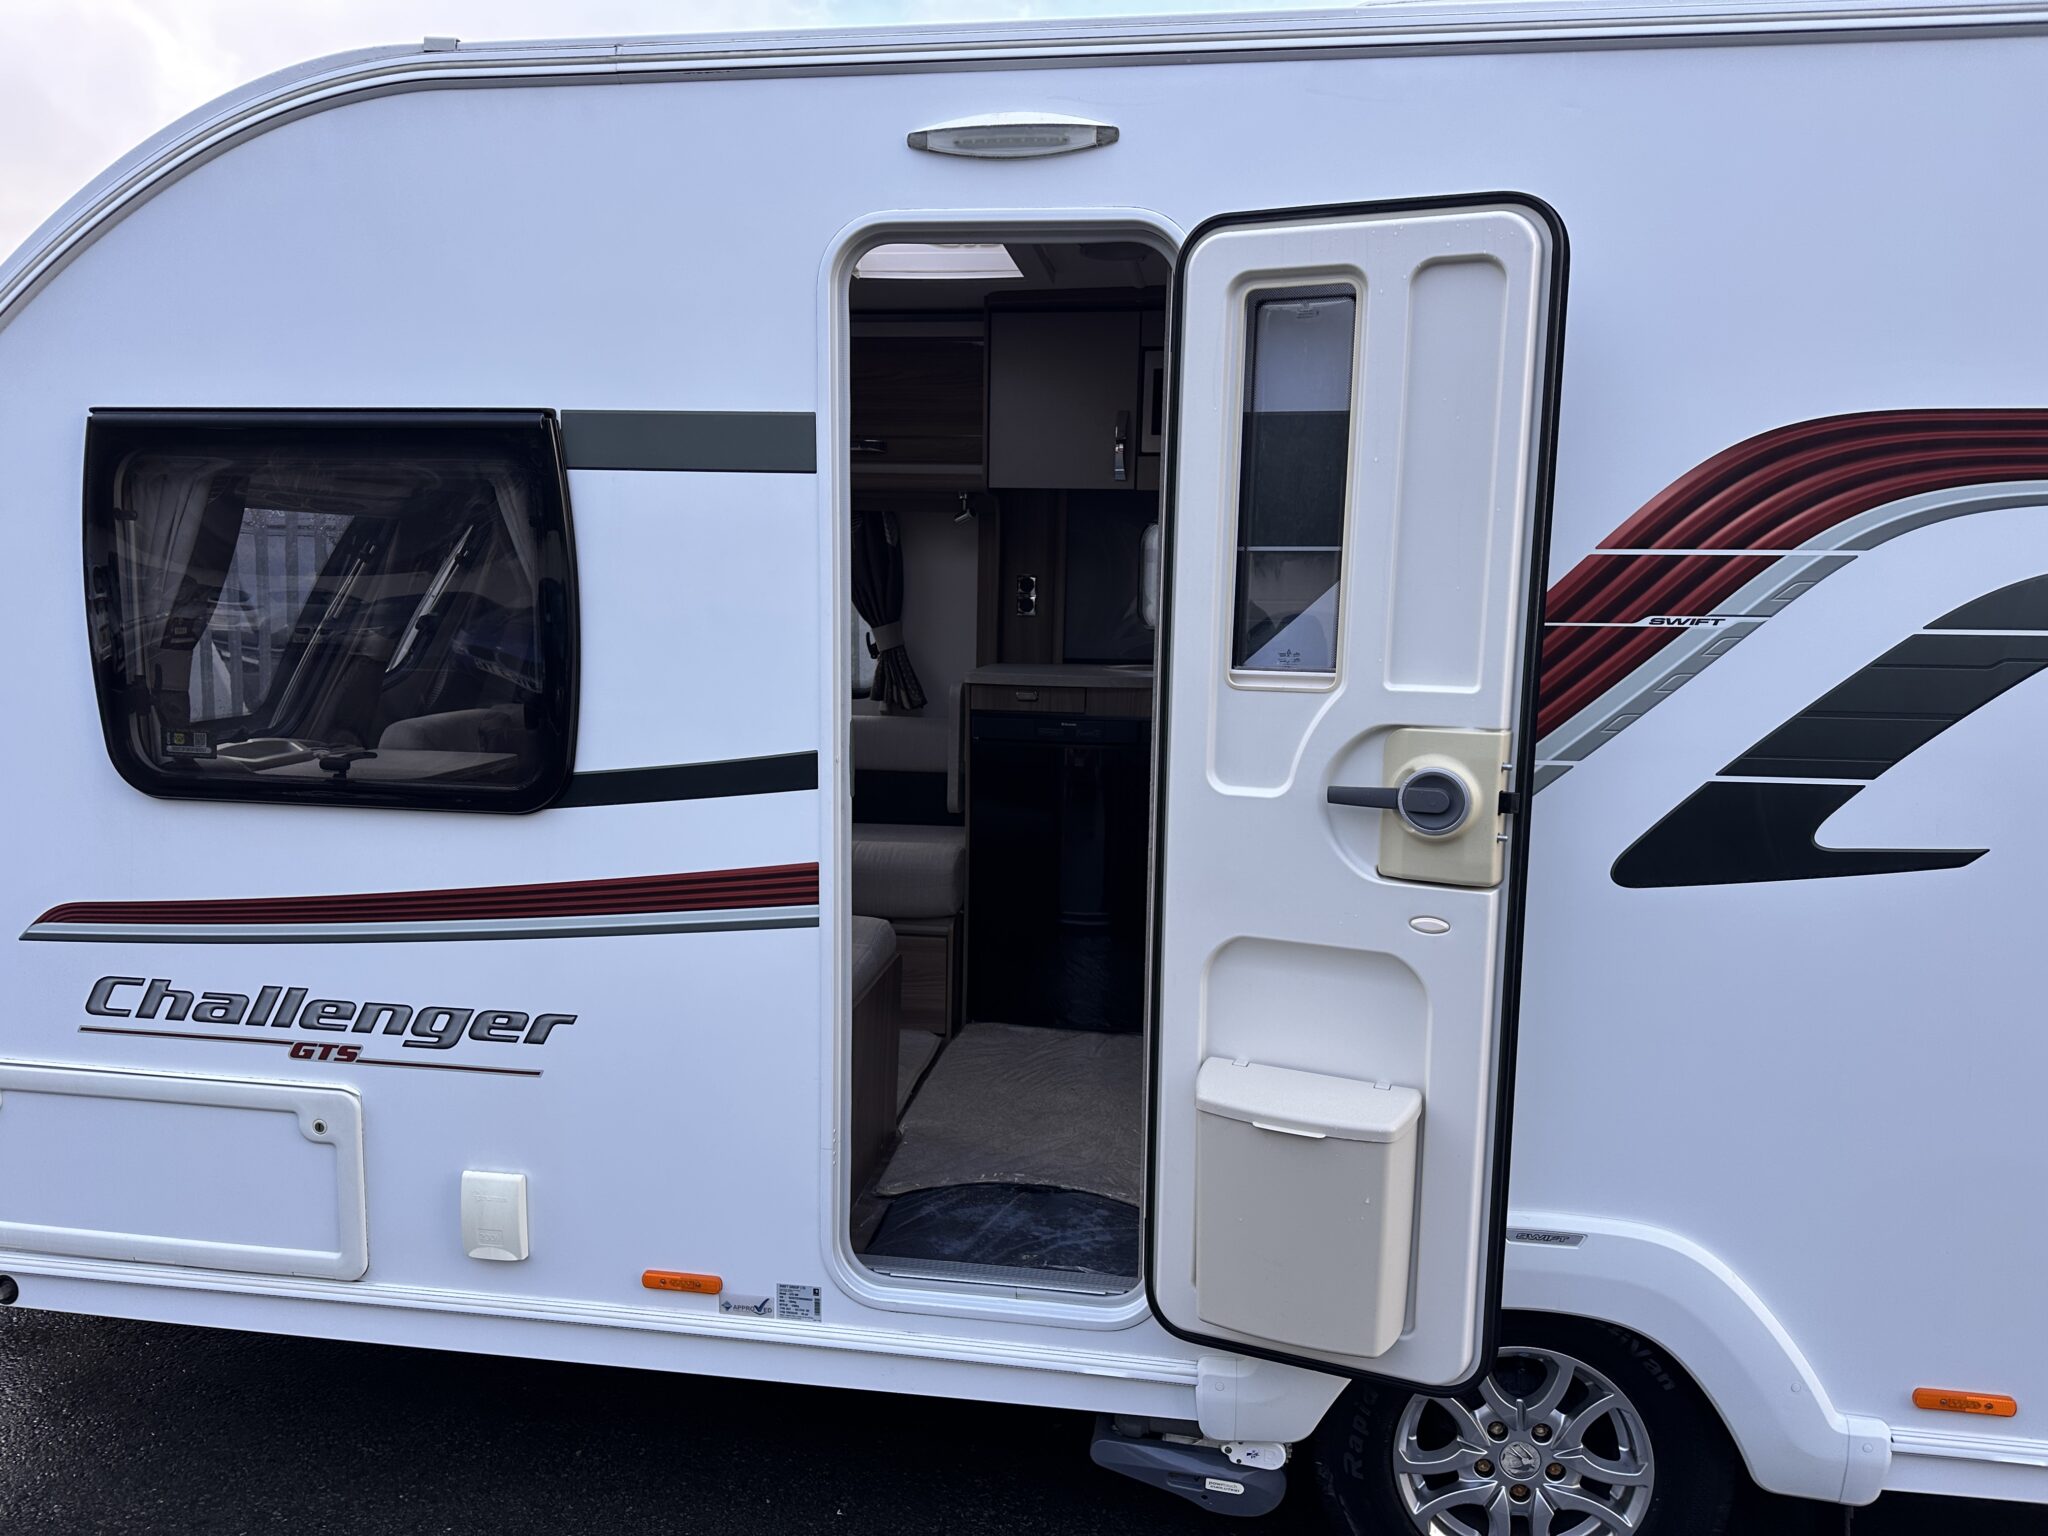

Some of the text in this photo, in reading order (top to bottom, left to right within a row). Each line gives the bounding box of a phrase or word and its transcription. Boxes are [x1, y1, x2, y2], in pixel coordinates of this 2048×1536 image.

[1649, 617, 1725, 626] SWIFT
[85, 975, 578, 1050] Challenger
[289, 1041, 363, 1064] GTS
[1516, 1233, 1570, 1242] SWIFT
